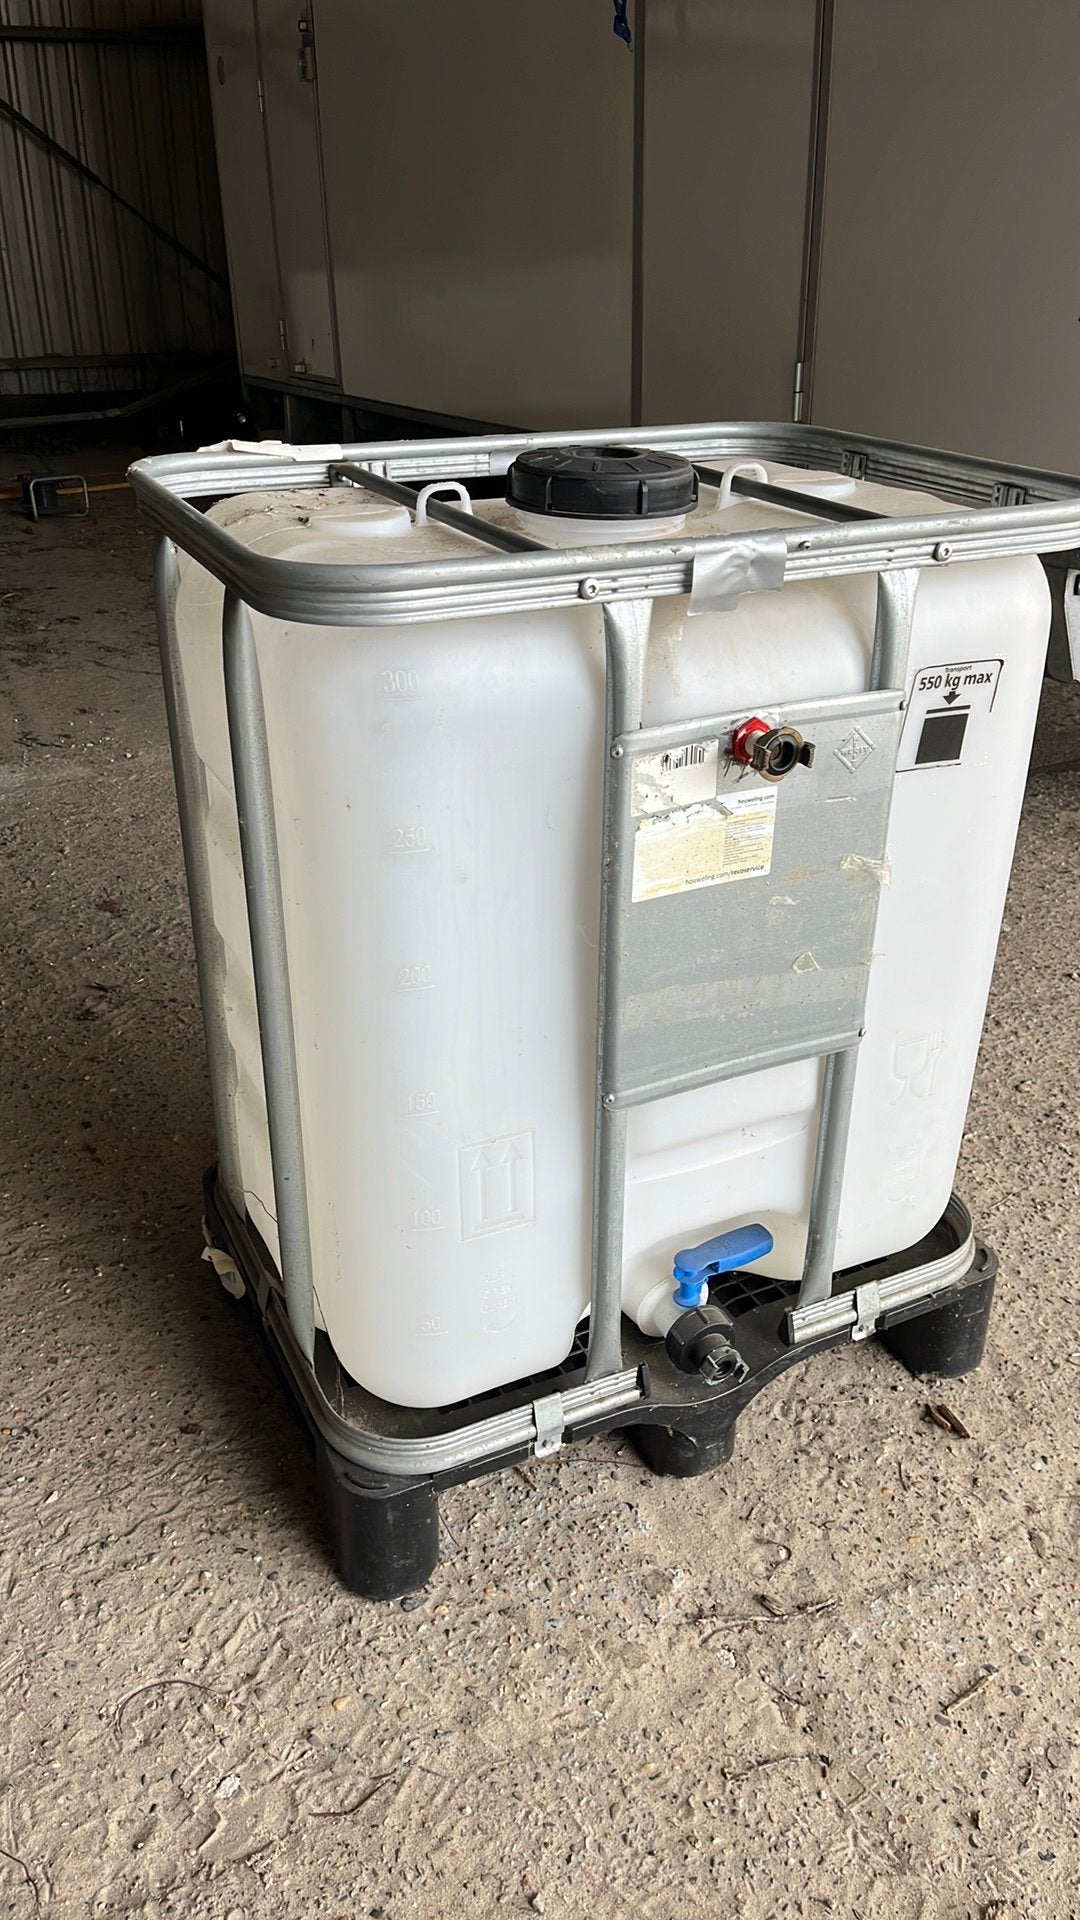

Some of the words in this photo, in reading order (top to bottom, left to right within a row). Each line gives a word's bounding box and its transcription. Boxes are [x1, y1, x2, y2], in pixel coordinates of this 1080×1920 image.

[944, 665, 972, 673] Transport
[383, 670, 420, 693] 300
[918, 675, 942, 691] 550
[944, 673, 961, 690] kg
[963, 672, 993, 685] max
[394, 827, 427, 847] 250
[400, 966, 432, 986] 200
[408, 1093, 436, 1110] 150
[413, 1209, 441, 1227] 100
[421, 1316, 441, 1333] 50
